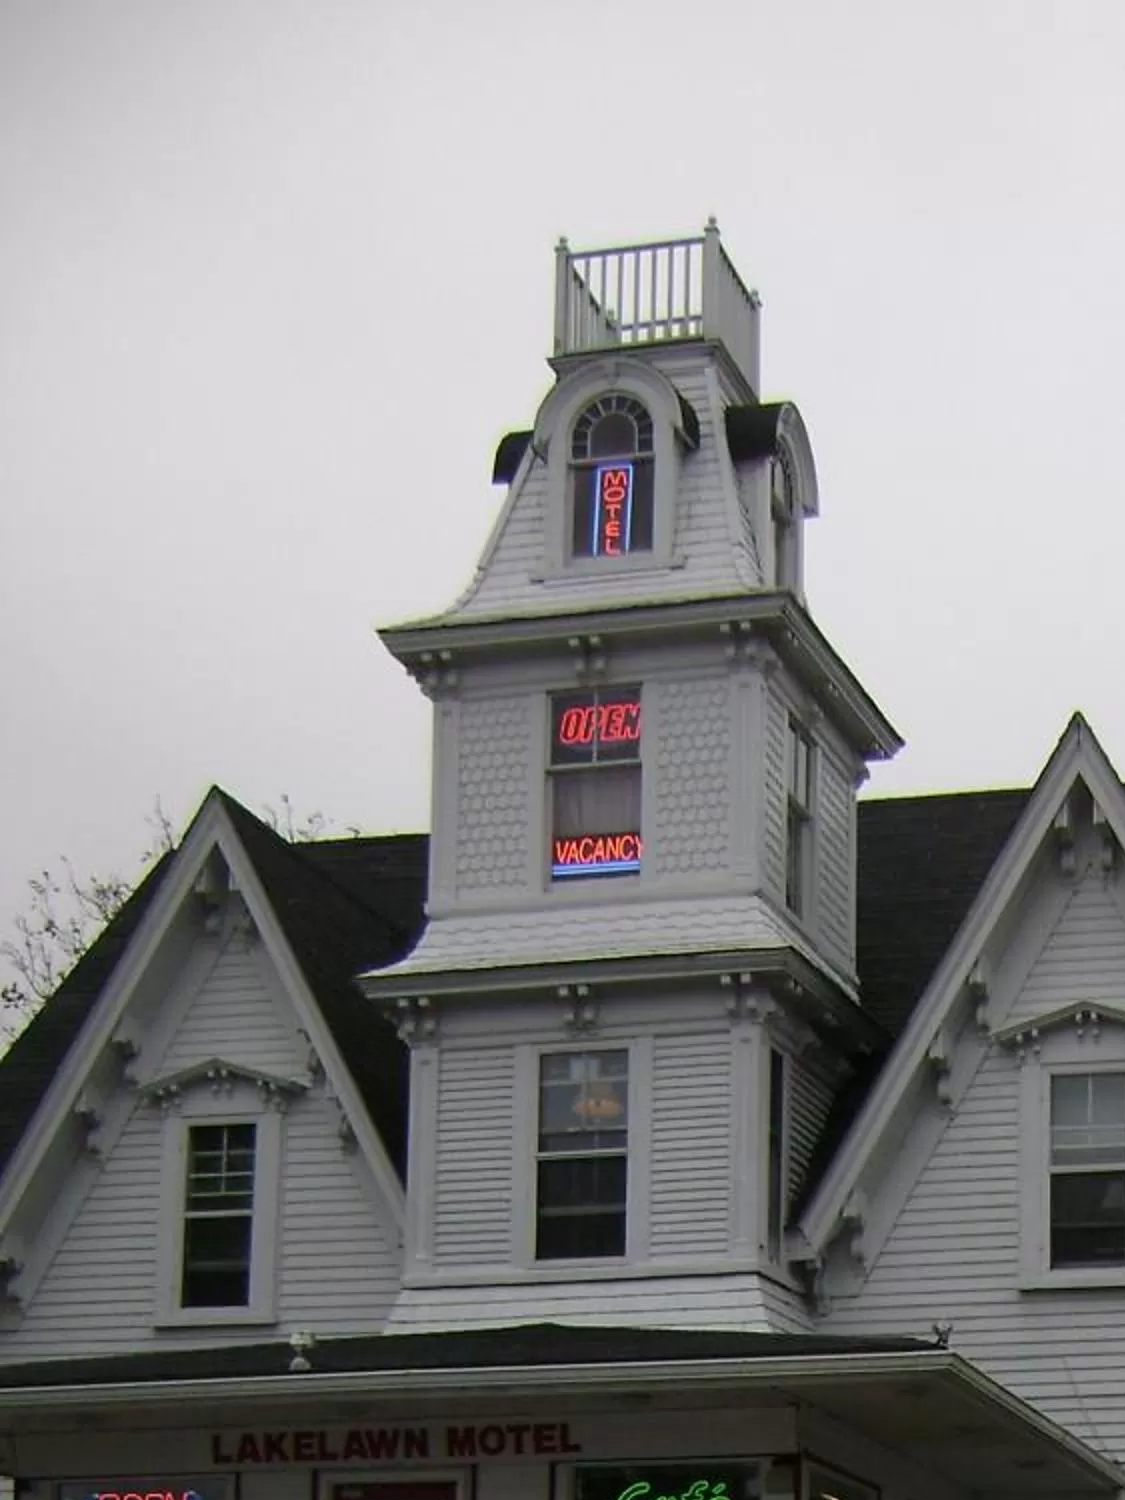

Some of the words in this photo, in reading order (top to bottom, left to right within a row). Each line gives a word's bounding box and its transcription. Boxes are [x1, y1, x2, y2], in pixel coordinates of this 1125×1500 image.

[603, 470, 627, 556] MOTEL
[559, 703, 641, 744] OPEN
[212, 1428, 428, 1464] LAKELAWN
[446, 1423, 582, 1456] MOTEL
